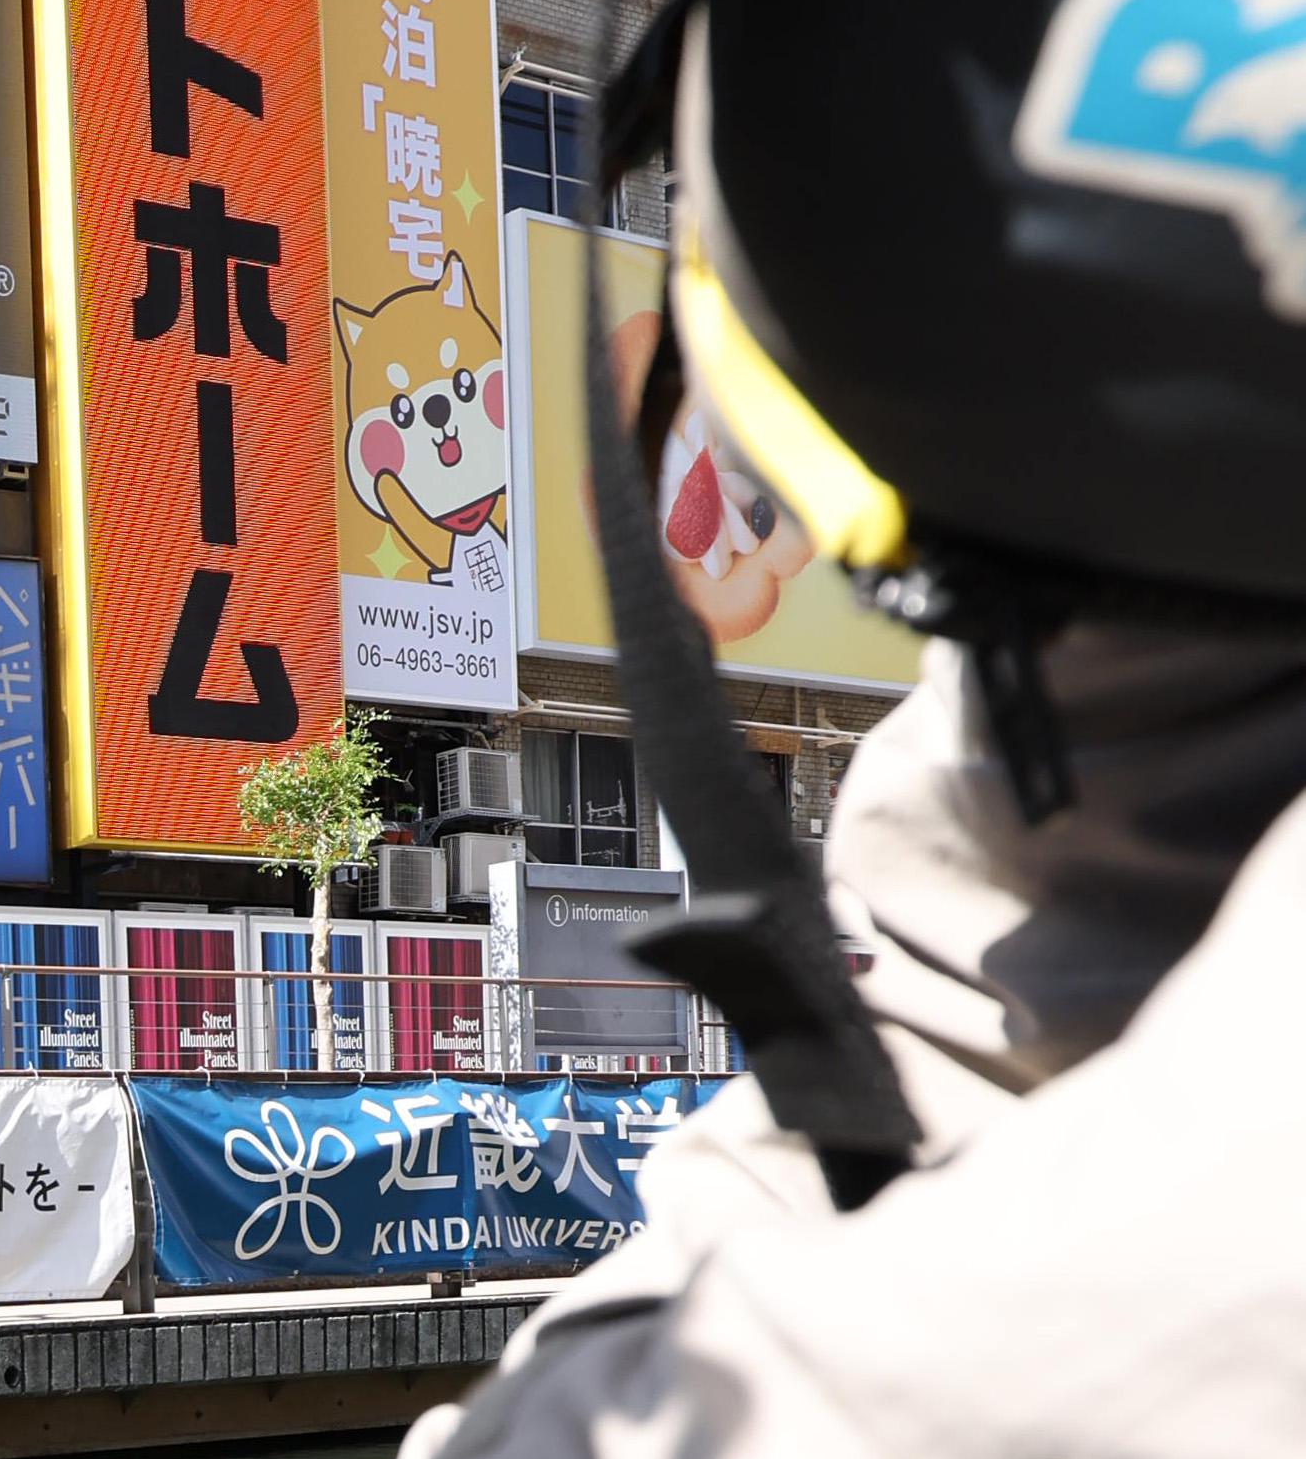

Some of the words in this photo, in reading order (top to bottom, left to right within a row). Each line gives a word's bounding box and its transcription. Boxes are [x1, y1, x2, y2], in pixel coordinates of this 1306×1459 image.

[357, 603, 494, 645] www.jsv.jp
[356, 642, 498, 679] 06-4963-3661
[572, 903, 649, 923] information
[63, 1008, 97, 1028] Street
[202, 1010, 233, 1030] Street
[332, 1013, 360, 1031] Street
[452, 1014, 481, 1032] Street
[371, 1215, 501, 1256] KINDAI
